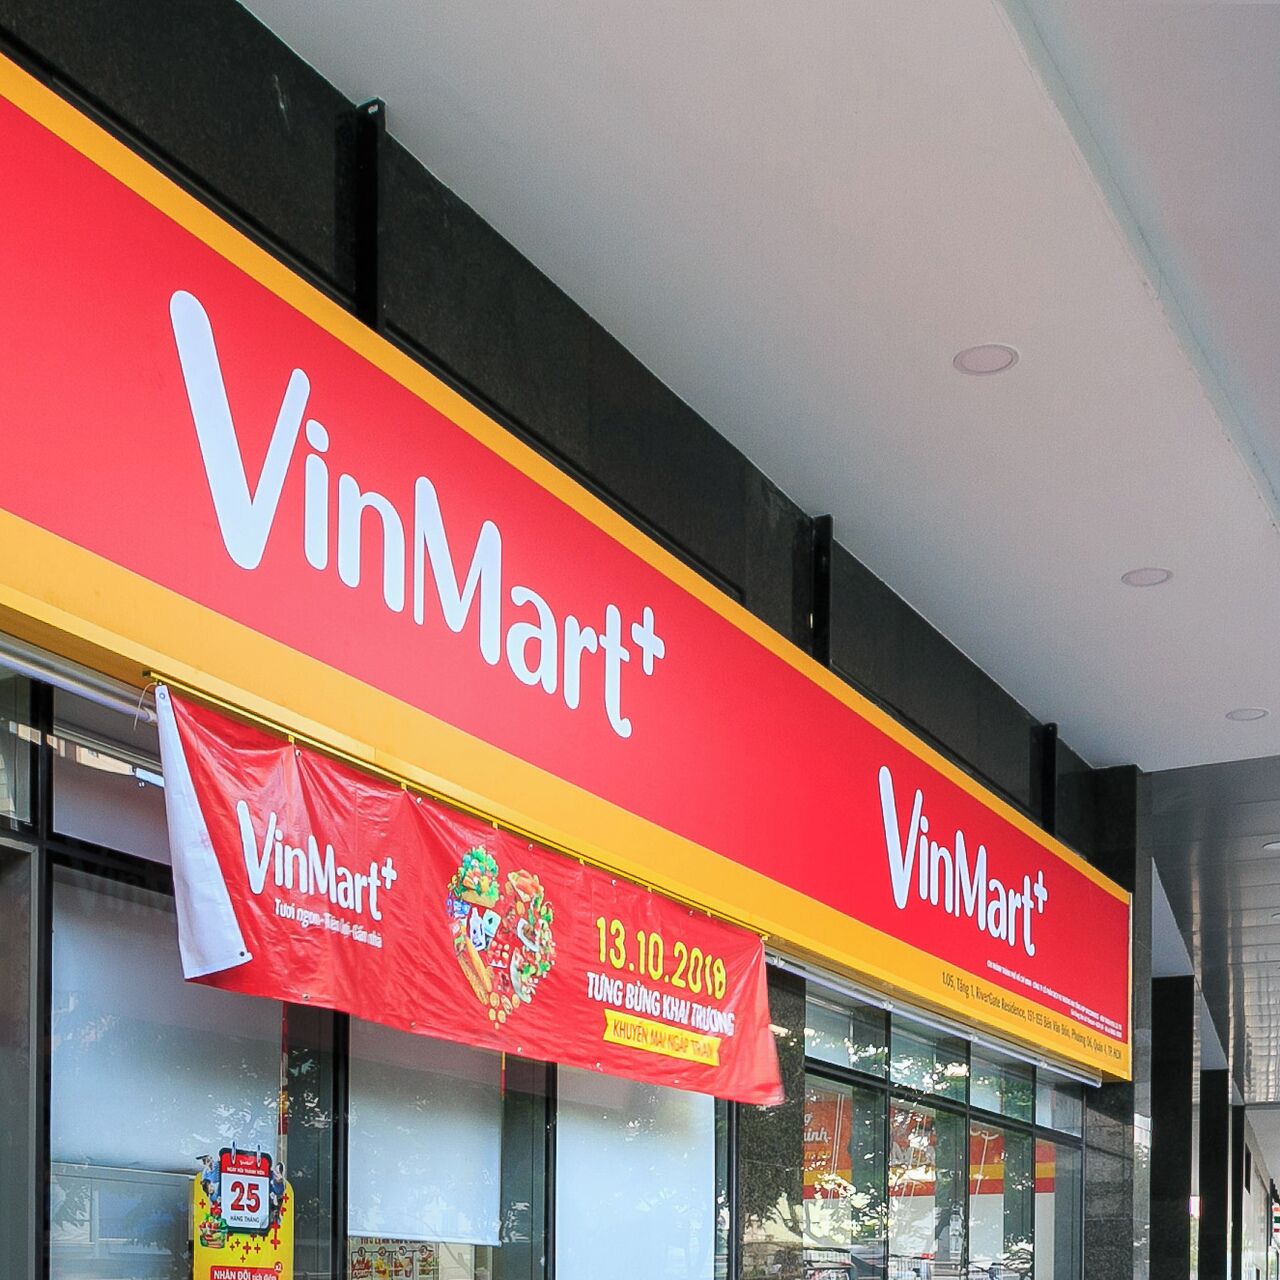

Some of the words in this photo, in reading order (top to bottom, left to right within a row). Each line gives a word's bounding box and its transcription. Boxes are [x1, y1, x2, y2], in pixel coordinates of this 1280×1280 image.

[596, 916, 727, 1000] 13.10.2018
[625, 980, 661, 1017] BỪNG
[662, 994, 691, 1025] KHAI
[691, 1003, 735, 1037] TRƯƠNG
[231, 1181, 261, 1213] 25
